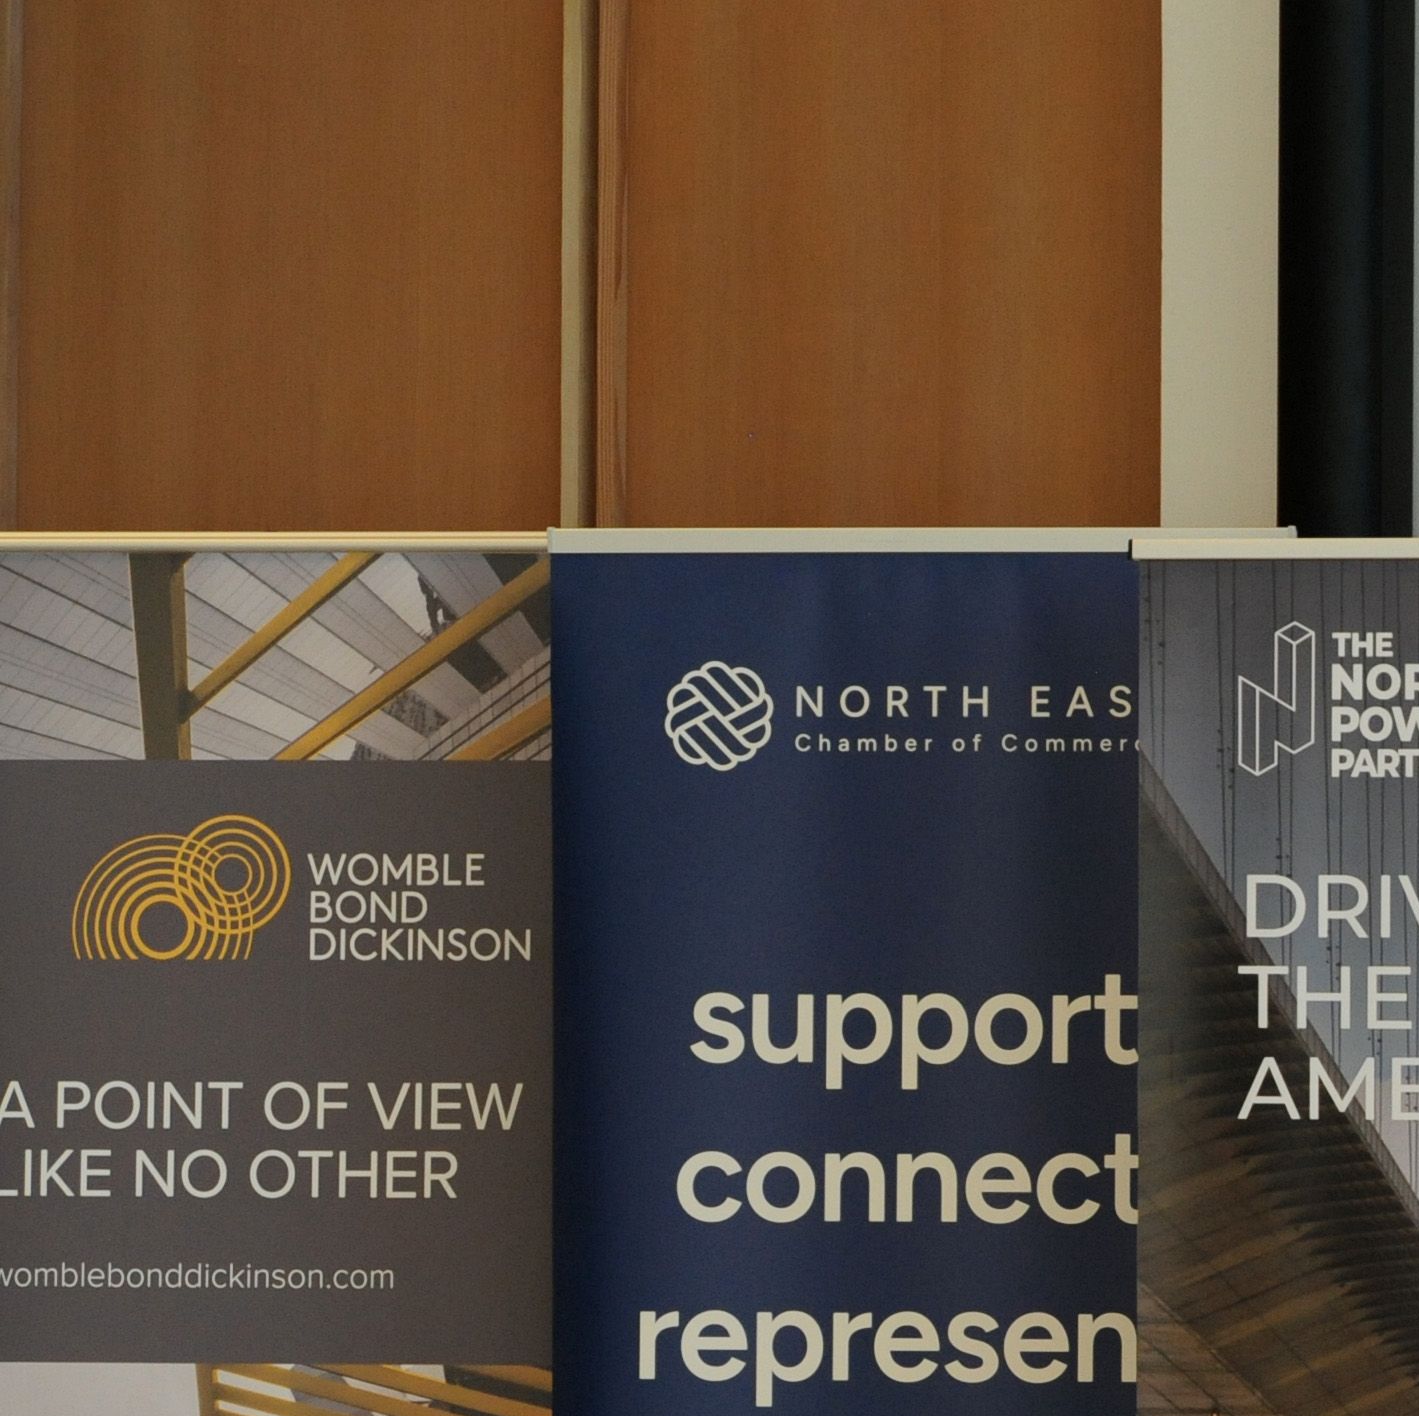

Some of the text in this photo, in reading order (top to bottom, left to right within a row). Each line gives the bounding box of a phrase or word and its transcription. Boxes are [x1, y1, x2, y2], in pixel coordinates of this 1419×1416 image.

[1331, 631, 1394, 658] THE
[796, 684, 990, 718] NORTH
[794, 733, 934, 753] Chamber
[951, 732, 983, 753] of
[307, 852, 485, 887] WOMBLE
[309, 890, 428, 924] BOND
[309, 927, 532, 963] DICKINSON
[1237, 964, 1413, 1030] THE
[689, 974, 1139, 1090] support
[0, 1080, 524, 1131] A POINT OF VIEW
[135, 1149, 228, 1199] NO
[249, 1149, 459, 1199] OTHER
[676, 1133, 1139, 1225] connect
[638, 1309, 1137, 1408] represen
